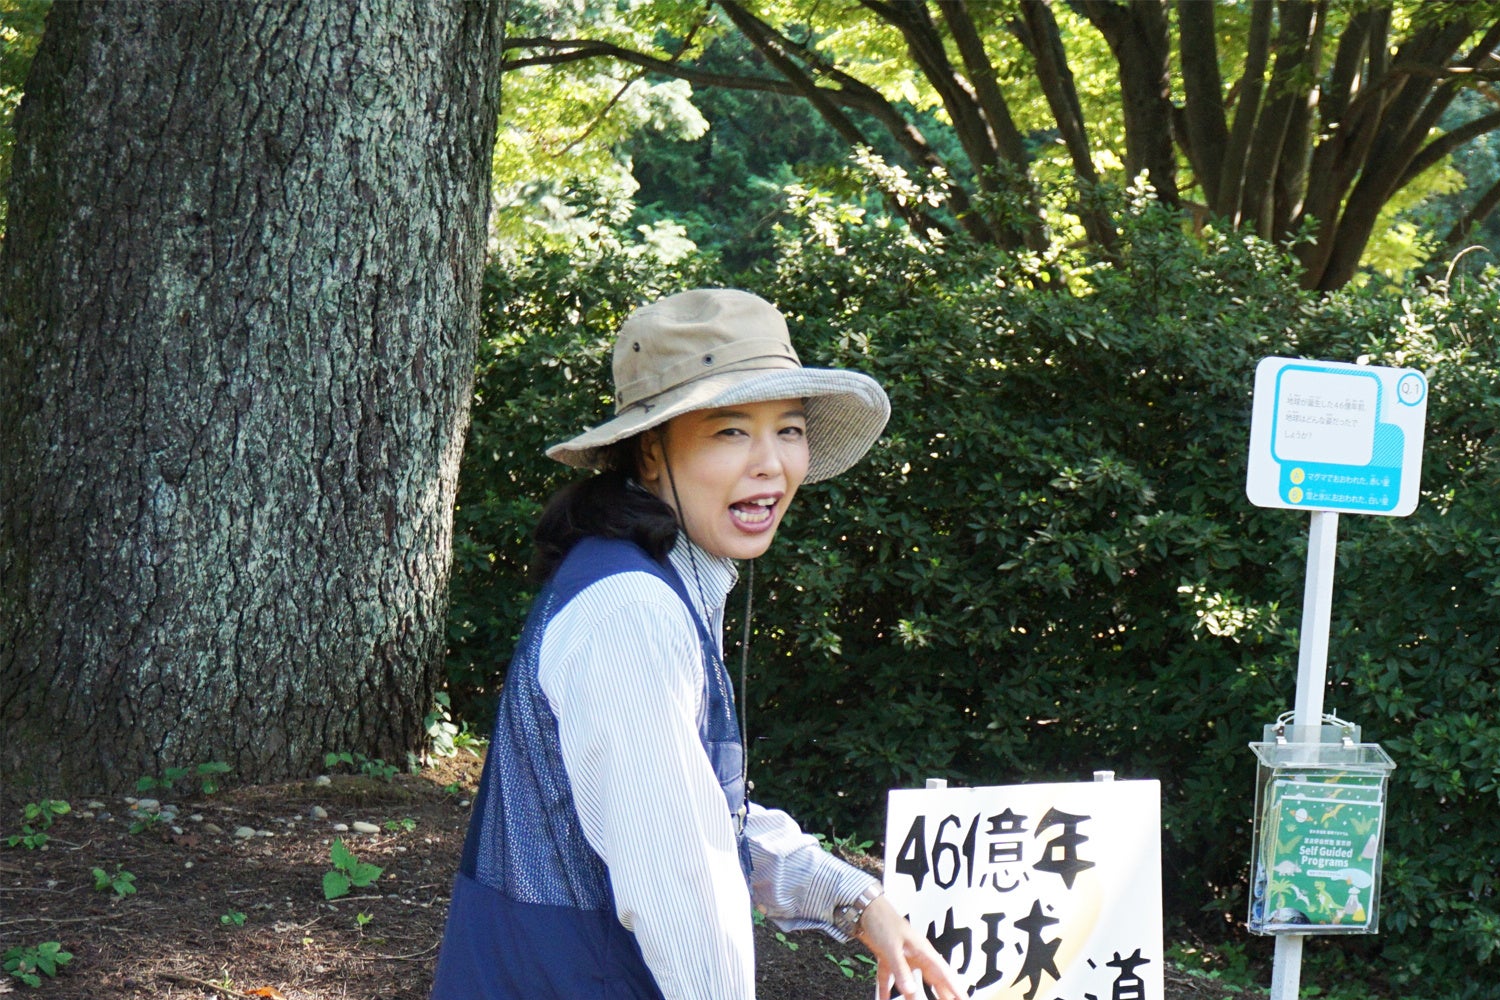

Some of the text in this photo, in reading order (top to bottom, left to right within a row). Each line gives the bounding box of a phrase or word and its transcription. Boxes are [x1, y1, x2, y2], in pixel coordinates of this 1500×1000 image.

[895, 807, 1095, 893] 46億年
[1299, 845, 1353, 858] Self Guided
[1301, 855, 1349, 868] Programs
